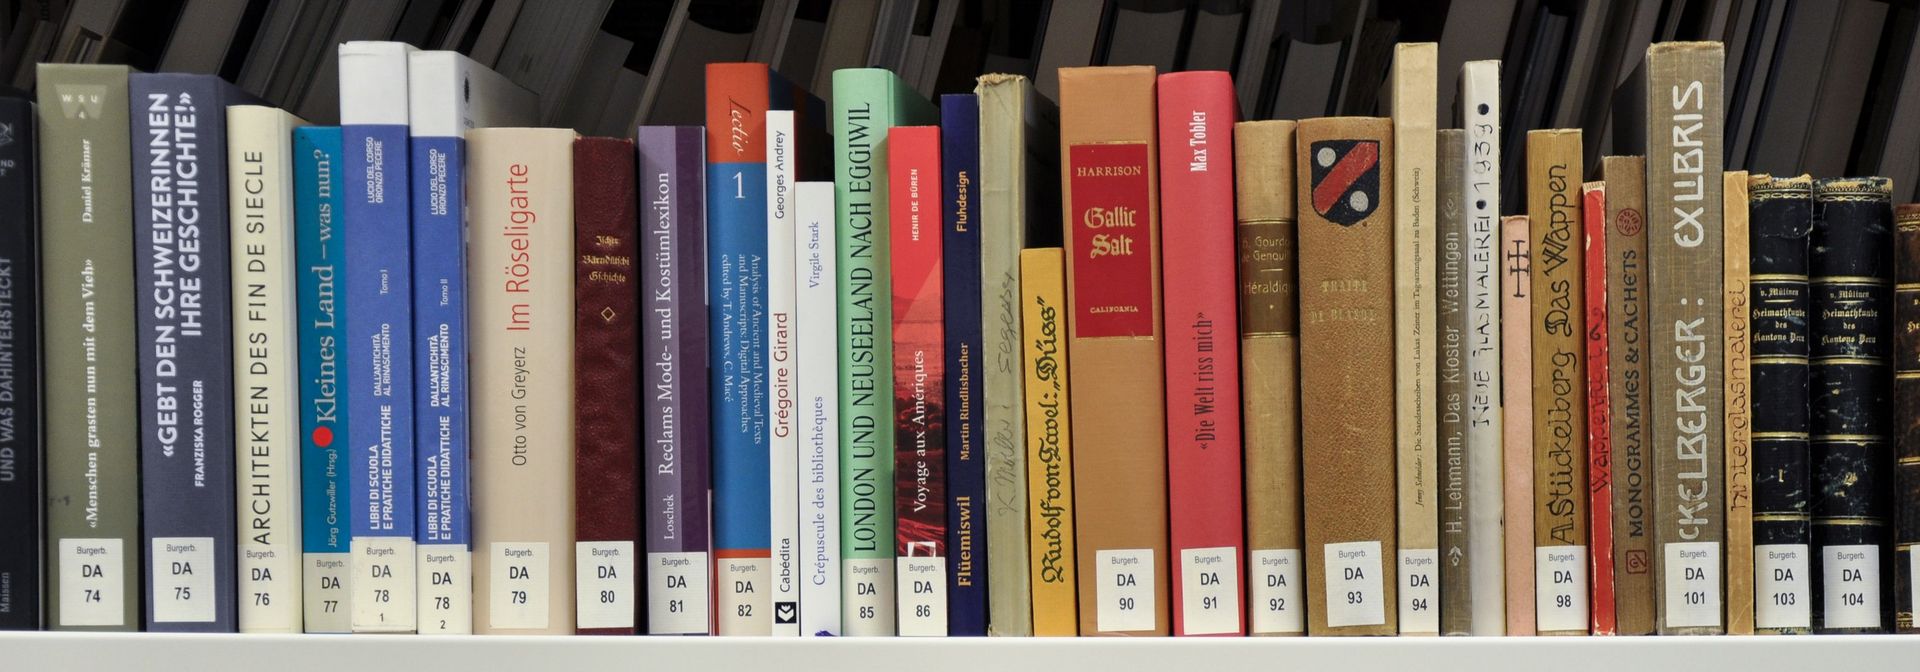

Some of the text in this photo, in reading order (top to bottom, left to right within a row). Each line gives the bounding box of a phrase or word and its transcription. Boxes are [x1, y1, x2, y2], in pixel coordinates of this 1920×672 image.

[1189, 110, 1207, 172] Max Tobler
[774, 130, 786, 219] Georges Andrey
[1077, 166, 1141, 177] HARRISON
[81, 139, 93, 223] Daniel Krämer
[732, 171, 746, 199] 1
[909, 168, 918, 198] BÜREN
[911, 200, 918, 211] DE
[956, 171, 969, 232] Fluhdesign
[175, 91, 202, 336] IHRE GESCHICHTE!»
[1084, 207, 1136, 228] Gallic
[1542, 164, 1576, 277] Wappen
[503, 163, 536, 331] Im Röseligarte
[1090, 234, 1133, 259] Salt
[808, 222, 822, 288] Virgile Stark
[149, 93, 177, 457] «GEBT DEN SCHWEIZERINNEN
[311, 149, 337, 423] Kleines Land was nun?
[1544, 280, 1572, 337] Das
[653, 172, 674, 475] Reclams Mode- und Kostümlexikon
[847, 102, 876, 551] LONDON UND NEUSEELAND NACH EGGIWIL
[1775, 321, 1787, 329] des
[245, 151, 271, 545] ARCHITEKTEN DES FIN DE SIECLE
[0, 257, 15, 482] UND WAS DAHINTERSTECKT
[774, 312, 792, 437] Grégoire Girard
[1192, 312, 1216, 450] «Die Welt riss mich»
[1441, 232, 1462, 533] H. Lehmann, Das Kloster Wettingen
[81, 258, 100, 529] «Menschen grasten nun mit dem Vieh»
[1622, 250, 1643, 537] MONOGRAMMES & CACHETS
[511, 346, 530, 466] Otto von Greyerz
[957, 342, 970, 461] Martin Rindlisbacher
[193, 380, 206, 487] FRANZISKA ROGGER
[911, 350, 929, 513] Voyage aux Amériques
[380, 404, 393, 530] E PRATICHE DIDATTICHE
[368, 445, 380, 530] LIBRI DI SCUOLA
[1045, 464, 1060, 500] von
[811, 396, 829, 586] Crépuscule des bibliothèques
[326, 449, 339, 548] Jörg Gutzwiller (Hrsg.)
[663, 494, 674, 540] Loschek
[956, 496, 972, 587] Flüemiswil
[1040, 501, 1065, 583] Rudolf
[82, 565, 103, 578] DA
[172, 562, 193, 575] DA
[372, 565, 391, 578] DA
[780, 537, 790, 593] Cabédita
[252, 568, 272, 581] DA
[432, 572, 452, 585] DA
[509, 566, 529, 579] DA
[598, 566, 617, 579] DA
[1201, 573, 1220, 585] DA
[1345, 567, 1364, 580] DA
[1554, 571, 1573, 584] DA
[1685, 567, 1704, 580] DA
[1774, 568, 1793, 581] DA
[1843, 569, 1862, 582] DA
[321, 576, 340, 589] DA
[667, 576, 687, 588] DA
[735, 581, 754, 593] DA
[1117, 574, 1136, 587] DA
[1268, 575, 1286, 587] DA
[1410, 575, 1429, 587] DA
[175, 587, 191, 600] 75
[857, 583, 876, 595] DA
[914, 581, 933, 594] DA
[85, 590, 101, 602] 74
[254, 593, 270, 606] 76
[374, 590, 389, 603] 78
[511, 591, 527, 604] 79
[600, 591, 615, 603] 80
[1348, 591, 1363, 604] 93
[1556, 595, 1572, 607] 98
[1684, 592, 1705, 605] 101
[1773, 593, 1795, 605] 103
[1841, 593, 1864, 606] 104
[324, 601, 338, 613] 77
[434, 597, 450, 610] 78
[669, 600, 684, 613] 81
[1119, 598, 1134, 610] 90
[1203, 597, 1217, 609] 91
[1270, 598, 1285, 610] 92
[1412, 598, 1428, 611] 94
[738, 605, 752, 617] 82
[860, 607, 874, 618] 85
[916, 605, 930, 617] 86
